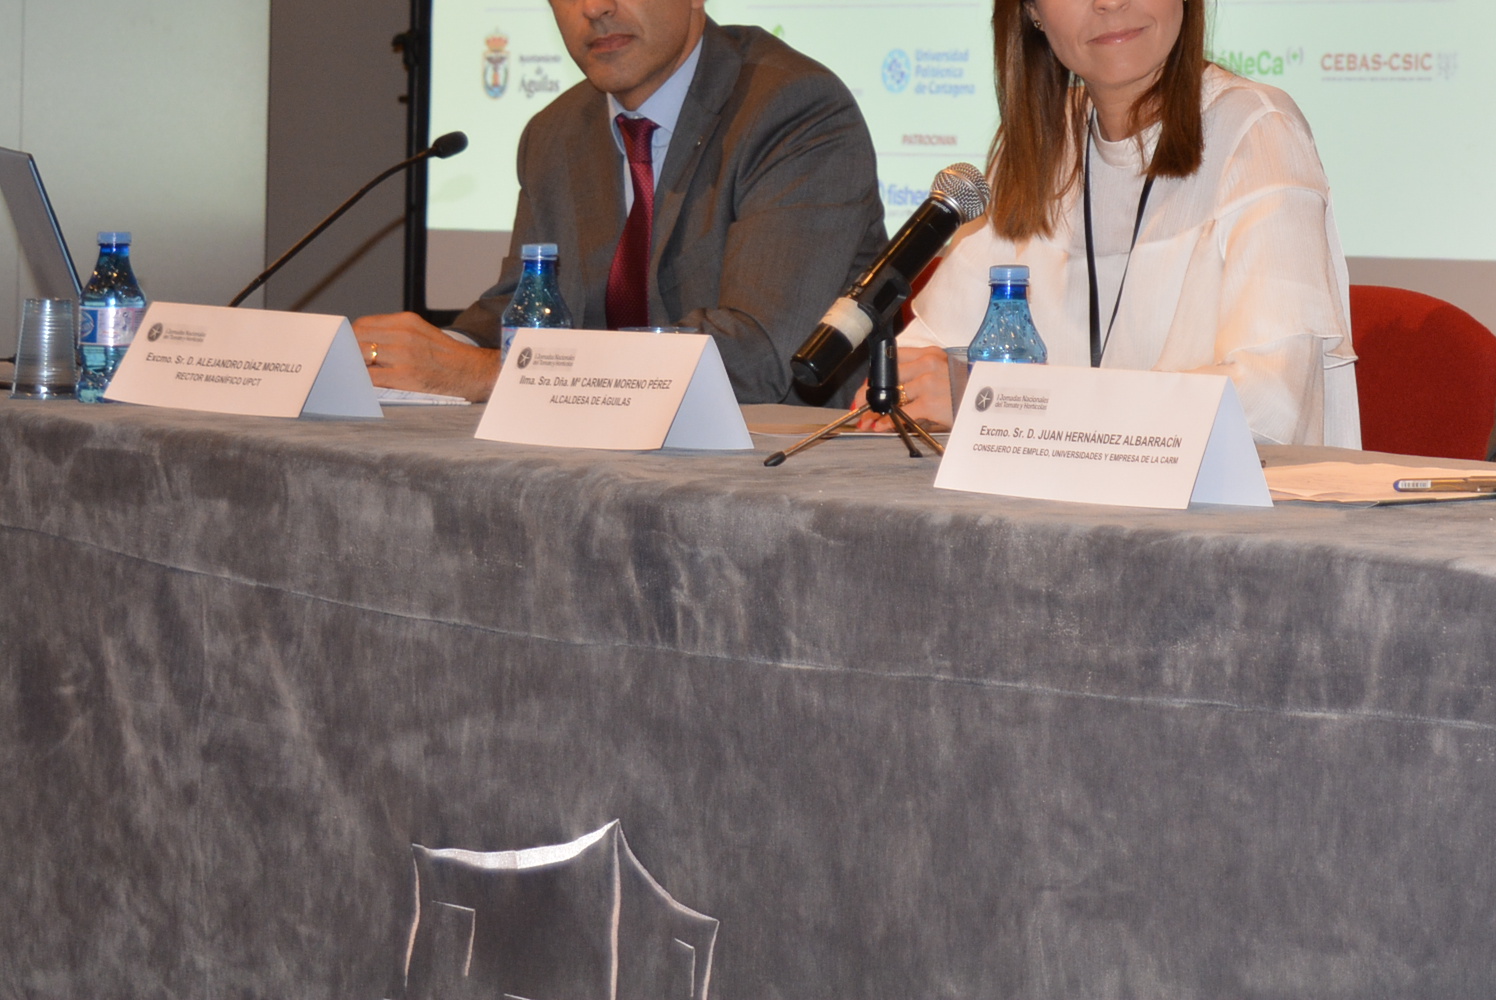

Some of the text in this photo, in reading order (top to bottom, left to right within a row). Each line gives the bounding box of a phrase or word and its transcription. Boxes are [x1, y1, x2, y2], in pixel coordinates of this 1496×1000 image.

[1320, 53, 1432, 71] CEBAS-CSIC
[915, 81, 926, 94] de
[146, 352, 302, 373] Excmo. Sr. D. ALEJANDRO DÍAZ MORCILLO
[175, 371, 262, 387] RECTOR MAGNÍFICO UPCT
[538, 376, 551, 386] Sra.
[581, 377, 613, 389] CARMEN
[613, 378, 647, 389] MORENO
[647, 377, 673, 390] PÉREZ
[550, 394, 632, 406] ALCALDESA DE ÁGUILAS
[1022, 395, 1049, 403] Nacionales
[979, 425, 1182, 448] Excmo. Sr. D. JUAN HERNÁNDEZ ALBARRACÍN
[972, 443, 1179, 465] CONSEJERO DE EMPLEO, UNIVERSIDADES Y EMPRESA DE LA CARM
